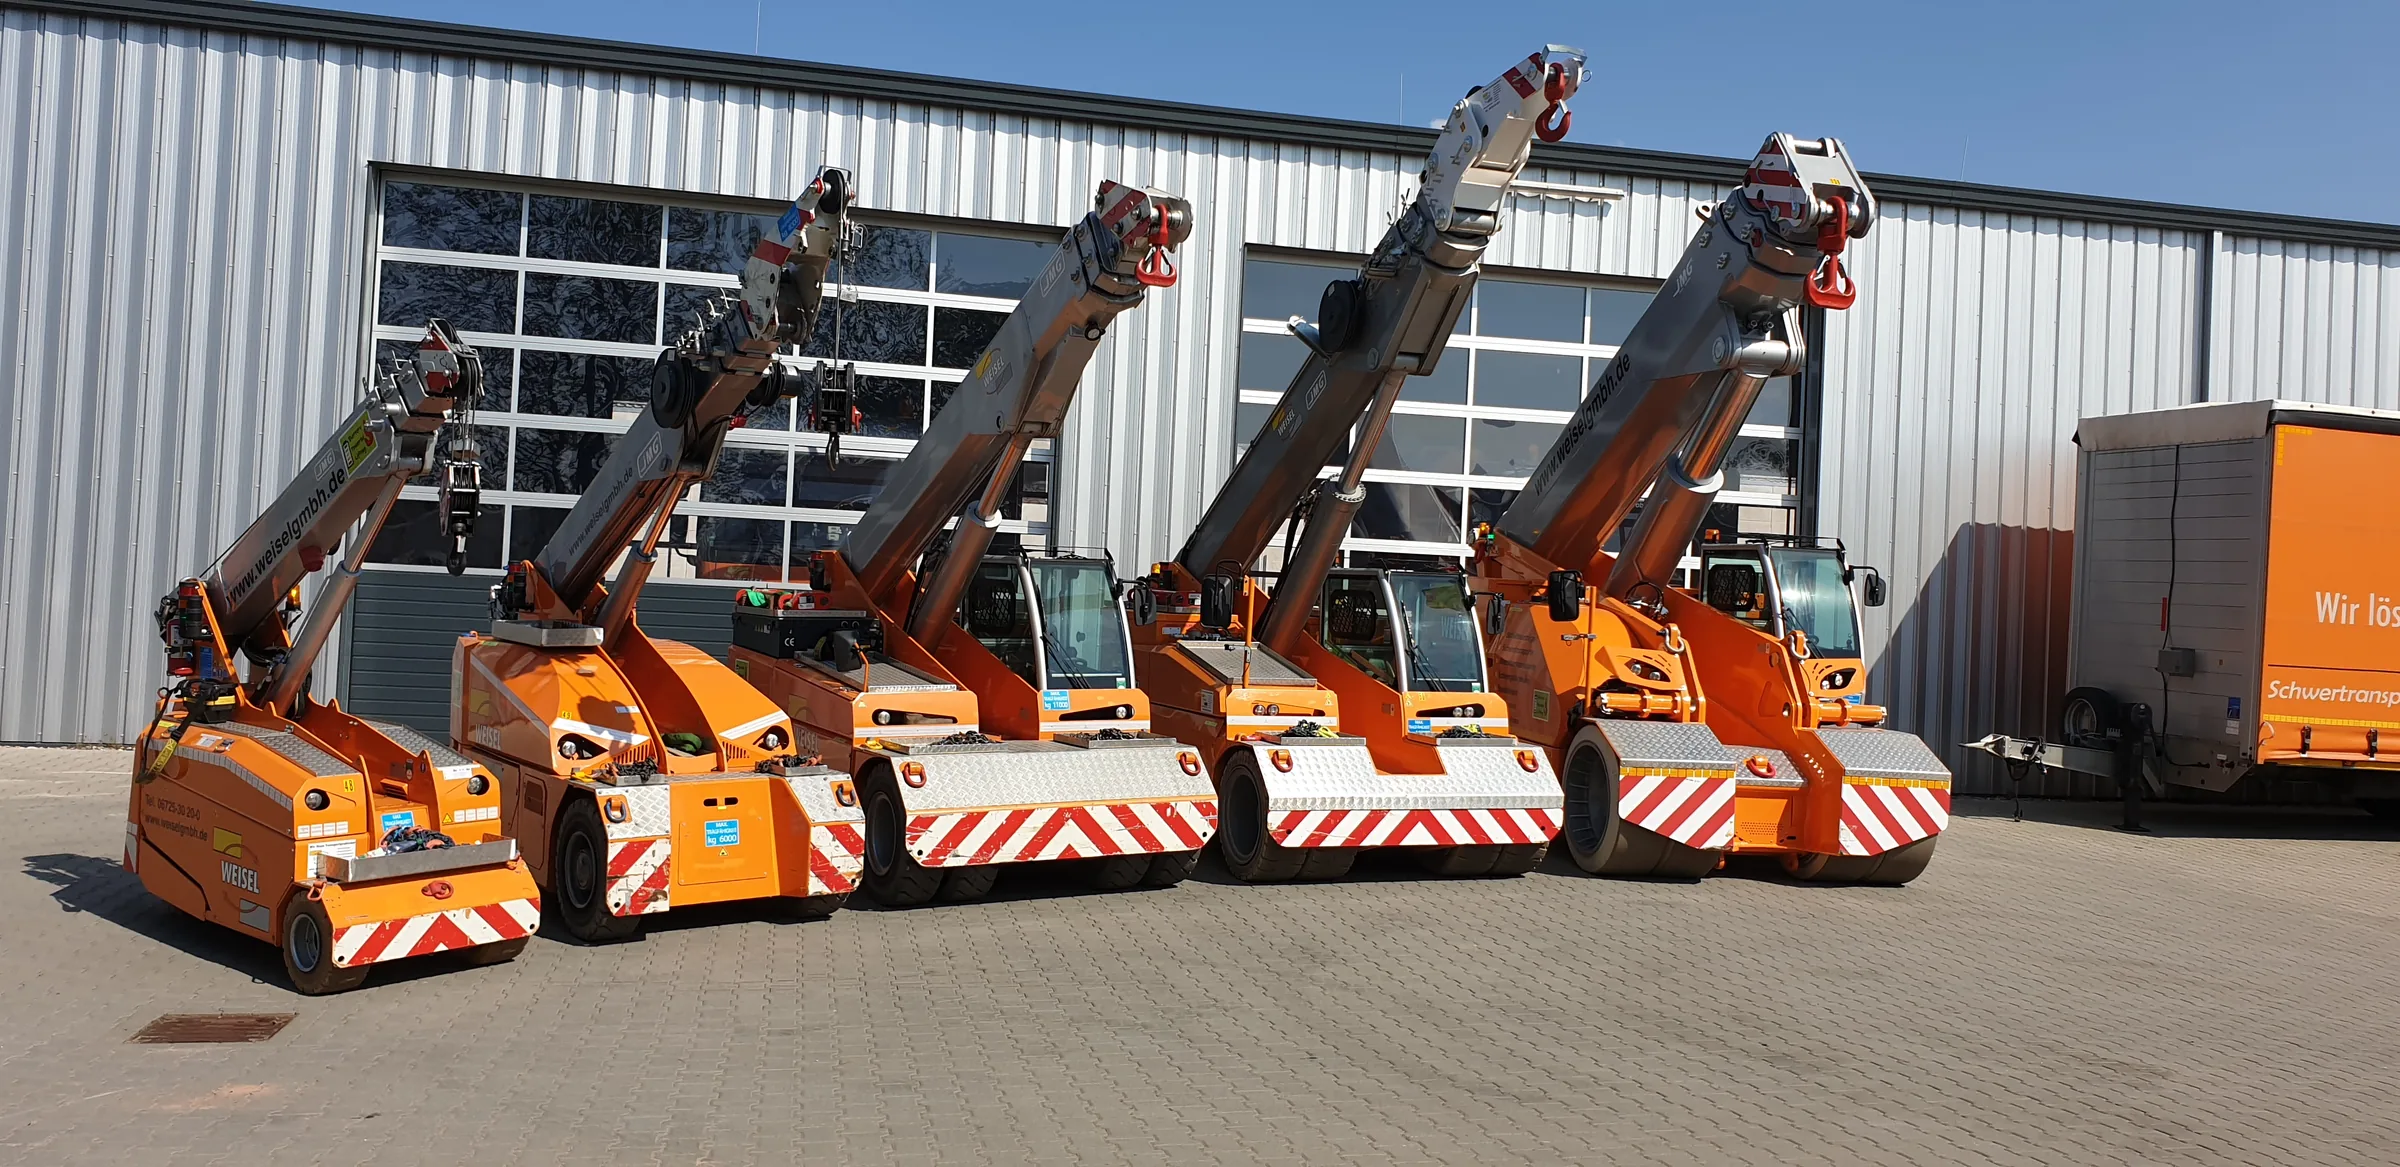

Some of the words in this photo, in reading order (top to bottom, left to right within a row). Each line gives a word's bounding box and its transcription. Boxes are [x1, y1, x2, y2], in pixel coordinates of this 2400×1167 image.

[1043, 253, 1062, 292] JMG
[1672, 257, 1693, 298] JMG
[983, 355, 1005, 388] WEISEL
[1308, 374, 1325, 406] JMG
[1277, 408, 1296, 437] WEISEL
[1534, 353, 1631, 497] www.weiselgmbh.de
[316, 451, 335, 478] JMG
[640, 439, 660, 471] JMG
[568, 466, 634, 557] www.weiselgmbh.de
[225, 468, 346, 606] www.weiselgmbh.de
[2315, 591, 2360, 625] Wir
[2368, 592, 2400, 628] lös
[784, 637, 795, 647] CE
[1044, 702, 1052, 710] kg
[1053, 701, 1069, 709] 11000
[2267, 680, 2400, 708] Schwertransp
[475, 723, 502, 751] WEISEL
[145, 793, 156, 807] Tel.
[344, 780, 354, 792] 48
[144, 814, 208, 842] www.weiselgmbh.de
[707, 835, 717, 845] kg
[719, 834, 737, 843] 6000
[221, 859, 260, 895] WEISEL
